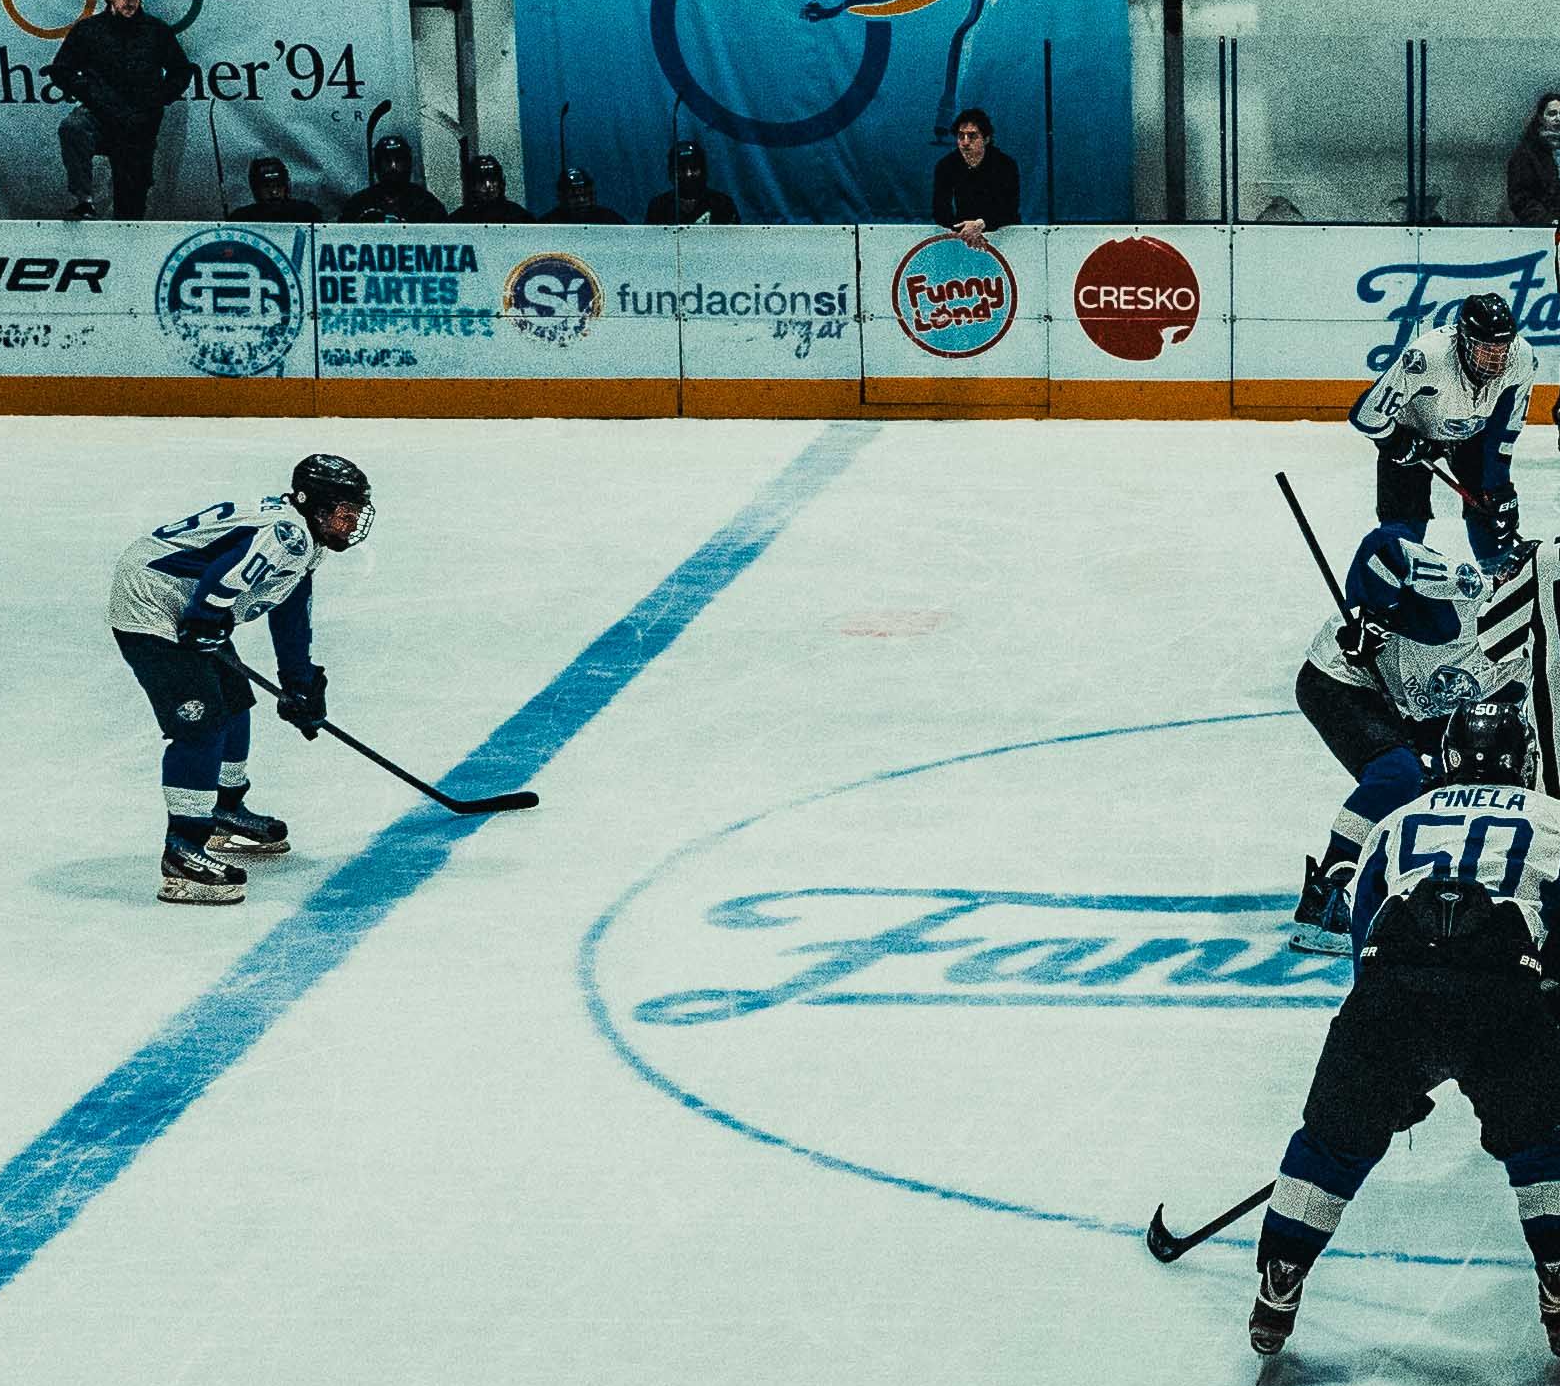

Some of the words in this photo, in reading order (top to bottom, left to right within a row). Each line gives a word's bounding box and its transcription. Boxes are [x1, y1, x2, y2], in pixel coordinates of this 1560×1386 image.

[319, 244, 478, 272] ACADEMIA
[320, 276, 357, 304] DE
[363, 276, 459, 304] ARTES
[906, 274, 1005, 310] Funny
[1078, 286, 1196, 311] CRESKO
[1374, 385, 1403, 416] 16
[1474, 703, 1498, 716] 50
[1429, 788, 1527, 812] PINELA
[1398, 813, 1535, 899] 50
